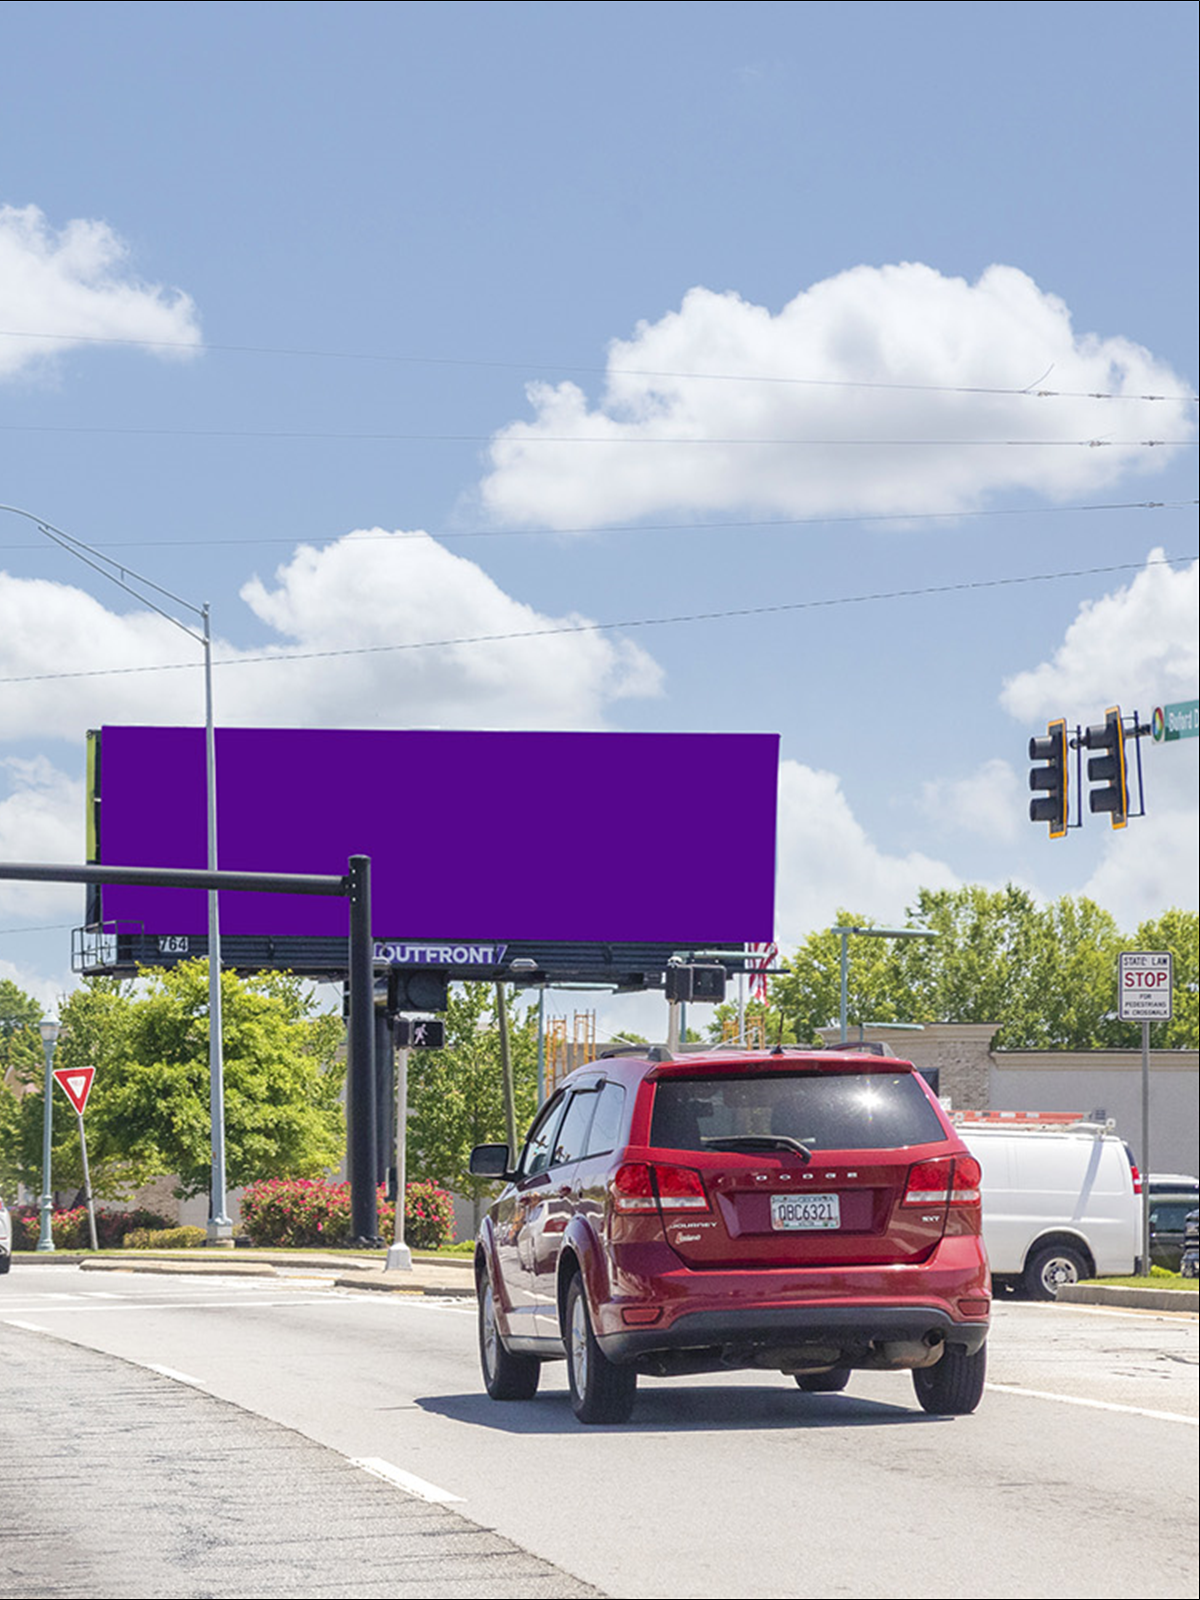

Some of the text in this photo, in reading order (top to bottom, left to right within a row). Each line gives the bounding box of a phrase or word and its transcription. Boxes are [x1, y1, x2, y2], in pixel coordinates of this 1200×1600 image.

[1169, 711, 1193, 732] Buford
[160, 936, 186, 951] 764
[380, 946, 494, 964] OUTFRONT
[1124, 957, 1168, 966] STATE LAW
[1124, 972, 1168, 988] STOP
[756, 1172, 858, 1181] DODGE
[778, 1203, 833, 1221] QBC6321
[669, 1222, 718, 1230] JOURNEY
